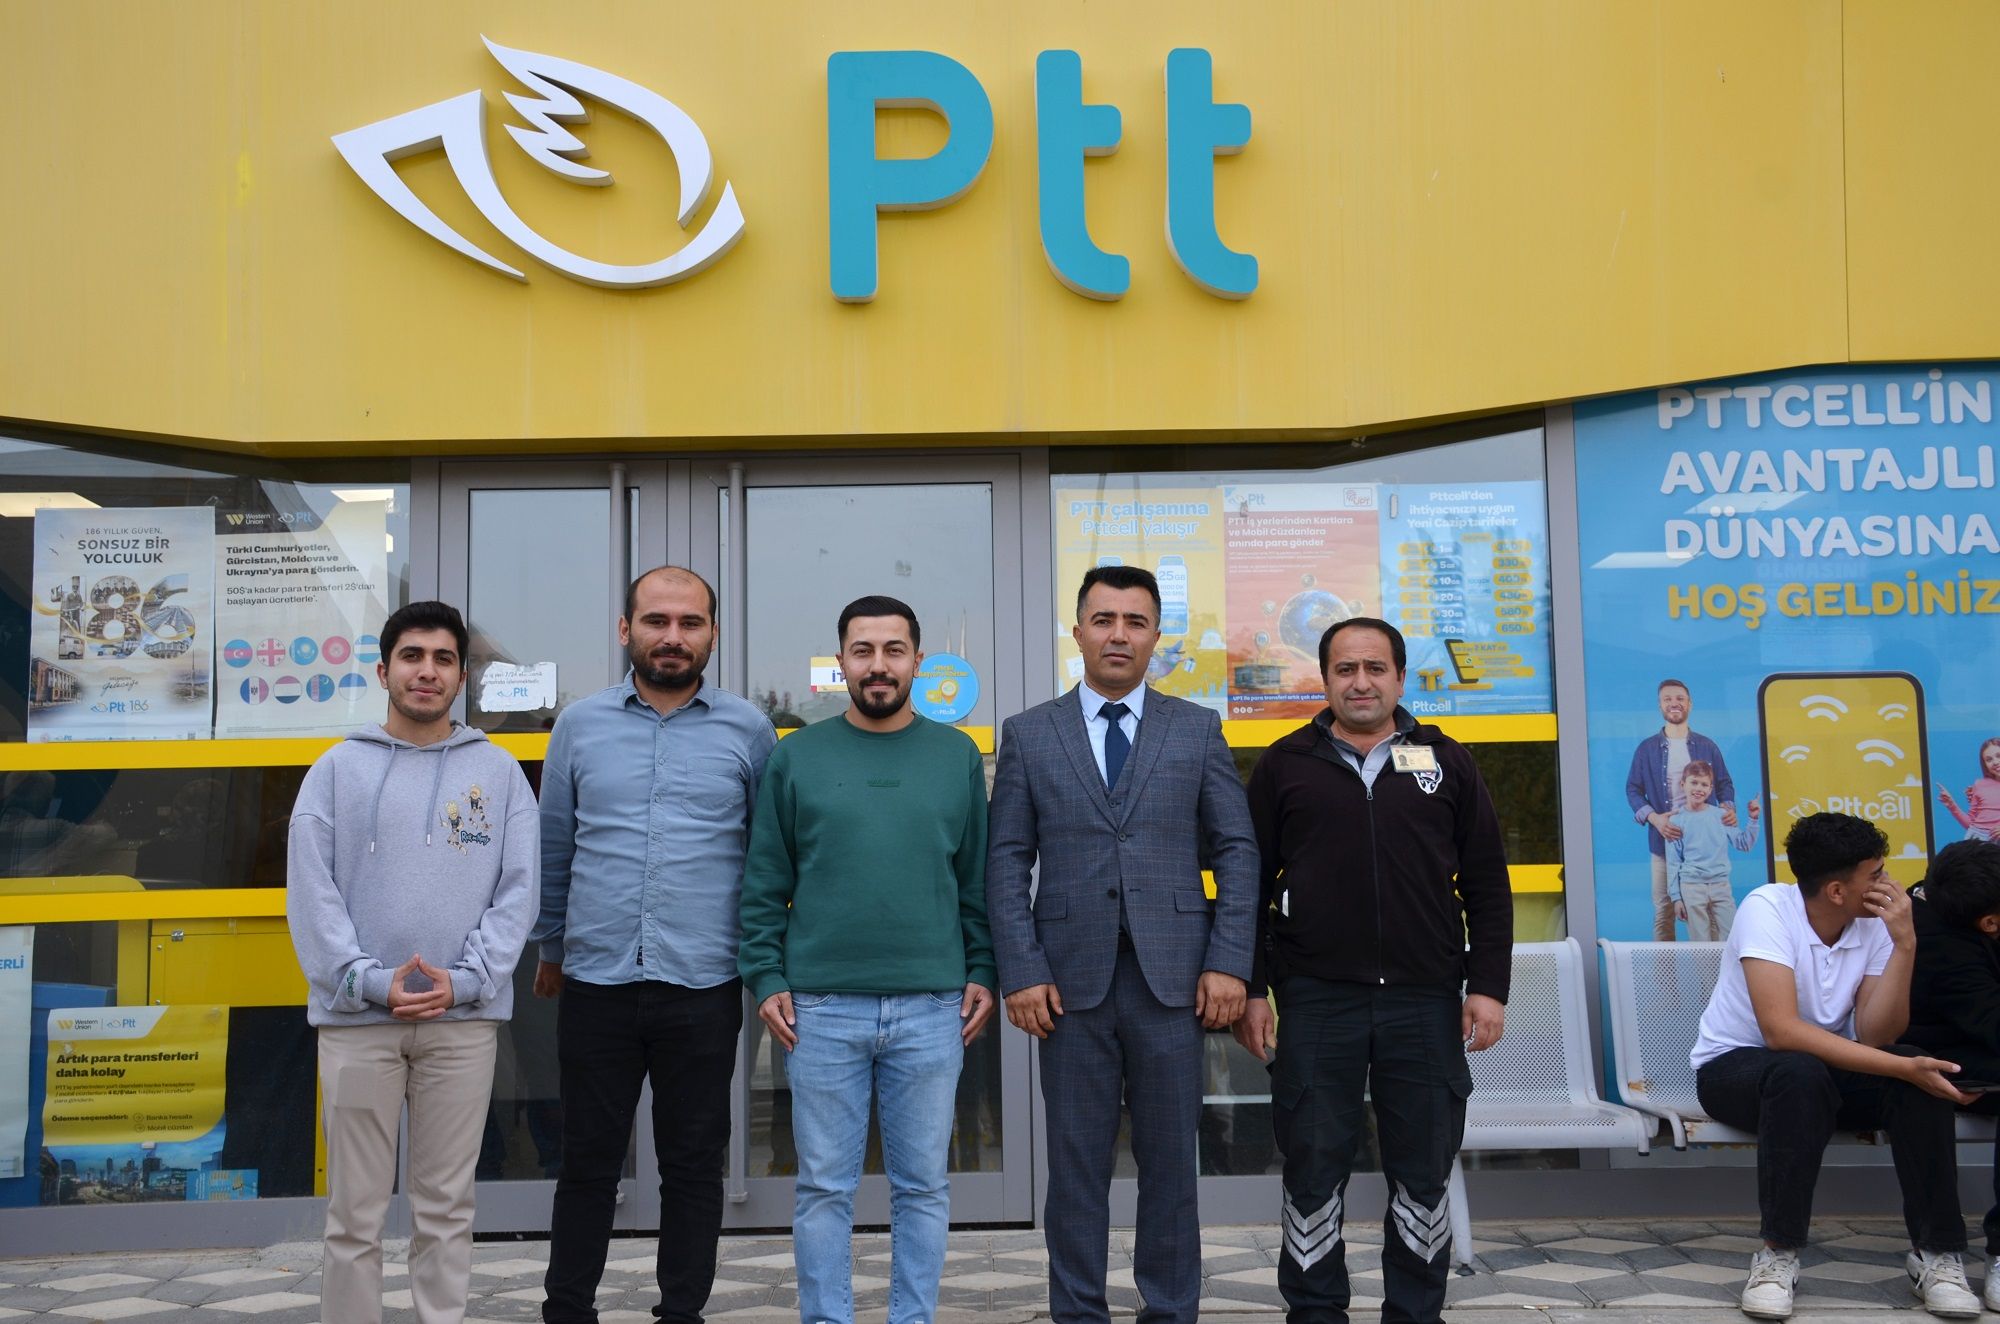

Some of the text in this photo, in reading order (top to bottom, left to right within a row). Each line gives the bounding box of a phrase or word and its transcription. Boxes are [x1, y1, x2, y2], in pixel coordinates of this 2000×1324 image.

[827, 48, 1258, 303] Ptt
[1657, 368, 1991, 430] PTTCELL'İN
[1659, 445, 1995, 495] AVANTAJLI
[1248, 493, 1266, 505] Ptt
[1071, 501, 1209, 520] PTT çalışanına
[1478, 504, 1515, 515] uygun
[295, 512, 313, 523] Ptt
[1228, 516, 1353, 527] PTT iş yerlerinden Kartlara
[1408, 516, 1519, 529] Yeni Cazip tarifeler
[1082, 520, 1198, 537] Pttcell yakışır
[1242, 527, 1268, 536] Mobil
[1270, 526, 1326, 536] Cüzdanlara
[1664, 505, 2000, 561] DÜNYASINA
[78, 536, 170, 550] SONSUZ BİR
[1228, 538, 1324, 549] anında para gönder
[226, 545, 252, 554] Türki
[83, 553, 163, 564] YOLCULUK
[226, 556, 280, 566] Gürcistan,
[281, 554, 325, 564] Moldova
[285, 568, 309, 577] para
[310, 565, 359, 575] gönderin.
[254, 586, 279, 594] kadar
[281, 586, 301, 595] para
[304, 584, 343, 592] transferi
[227, 597, 268, 606] başlayan
[1667, 569, 2000, 630] HOŞ GELDİNİZ
[51, 574, 196, 660] 186
[513, 687, 528, 697] Ptt
[110, 700, 149, 712] Ptt 186
[1412, 700, 1451, 712] Pttcell
[1827, 796, 1911, 820] Pttcell
[122, 1018, 136, 1028] Ptt
[56, 1051, 199, 1065] Artık para transferleri
[56, 1067, 126, 1079] daha kolay
